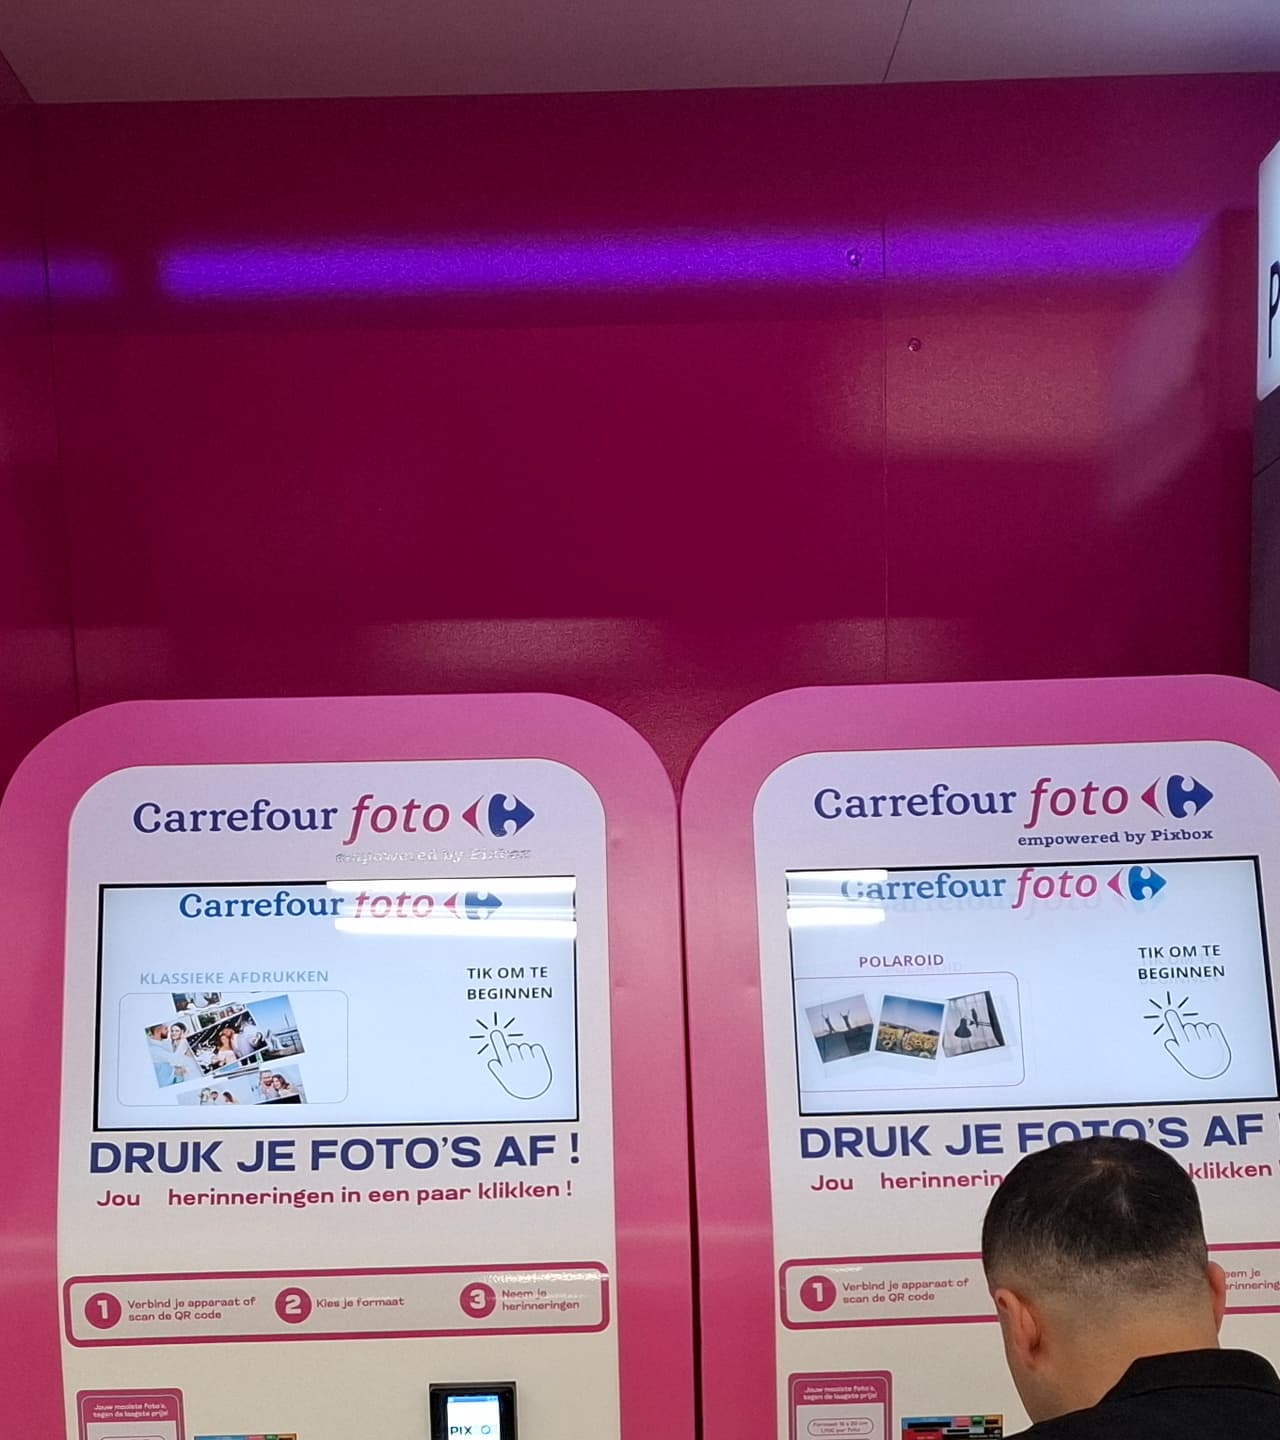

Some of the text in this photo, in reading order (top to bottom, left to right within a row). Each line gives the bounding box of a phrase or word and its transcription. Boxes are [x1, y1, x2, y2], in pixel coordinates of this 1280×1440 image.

[813, 777, 1128, 829] Carrefour foto
[132, 794, 451, 846] Carrefour foto
[1018, 827, 1214, 849] empowered by Pixbox
[840, 867, 1098, 909] Carrefour foto
[179, 890, 434, 921] Carrefour foto
[1138, 944, 1221, 960] TIK OM TE
[859, 954, 944, 969] POLAROID
[140, 970, 329, 985] KLASSIEKE AFDRUKKEN
[467, 965, 549, 980] TIK OM TE
[1138, 965, 1226, 980] BEGINNEN
[467, 986, 553, 1000] BEGINNEN
[799, 1125, 932, 1159] DRUK
[946, 1123, 1004, 1156] JE
[1203, 1114, 1264, 1147] AF
[89, 1134, 557, 1175] DRUK JE FOTO'S AF
[810, 1160, 1273, 1192] Jou klikken
[97, 1180, 560, 1209] Jou herinneringen in een paar klikken
[843, 1278, 969, 1292] Verbind je apparaat of
[128, 1297, 256, 1310] Verbind je apparaat of
[317, 1296, 405, 1310] Kies je formaat
[843, 1292, 935, 1303] scan de QR code
[128, 1310, 221, 1321] scan de QR code
